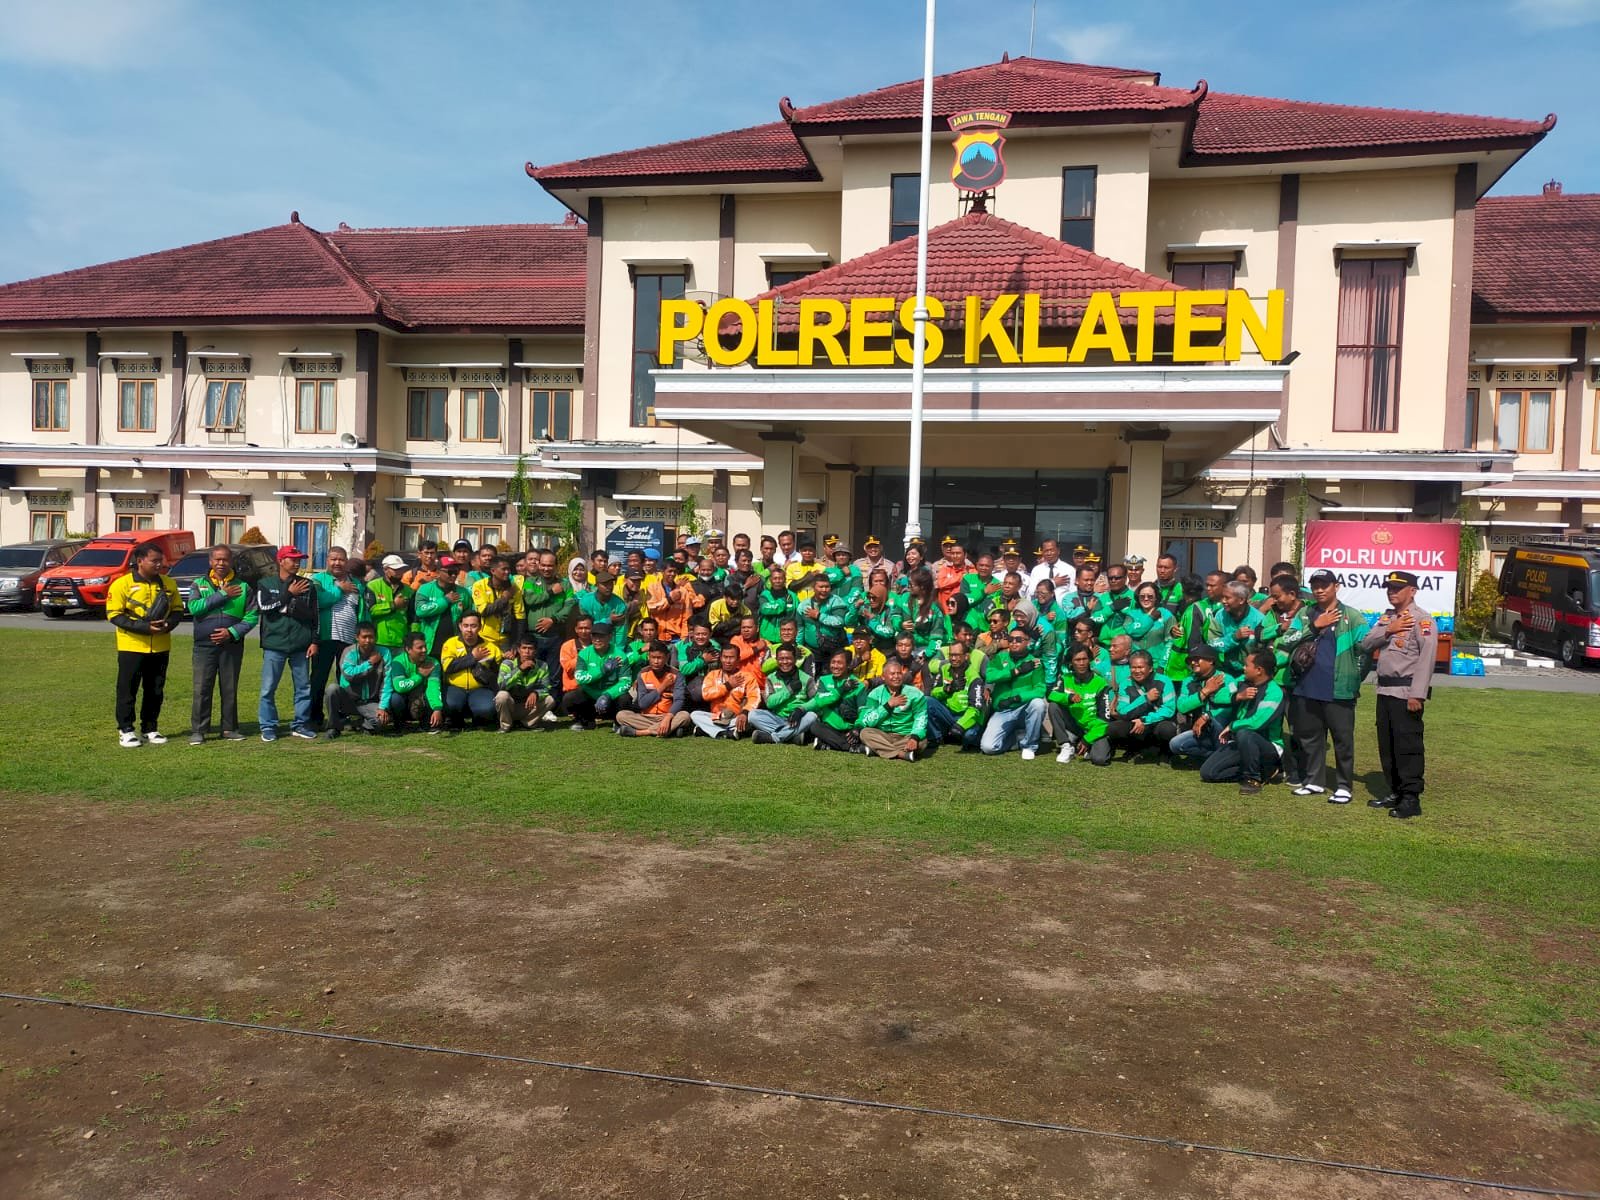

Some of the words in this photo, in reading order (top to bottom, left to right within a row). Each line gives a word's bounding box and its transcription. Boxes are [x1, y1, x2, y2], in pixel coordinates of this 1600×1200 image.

[953, 113, 973, 127] JAWA
[976, 112, 1007, 123] TENGAH
[659, 296, 945, 366] POLRES
[964, 288, 1285, 364] KLATEN
[1320, 548, 1375, 565] POLRI
[1381, 549, 1445, 567] UNTUK
